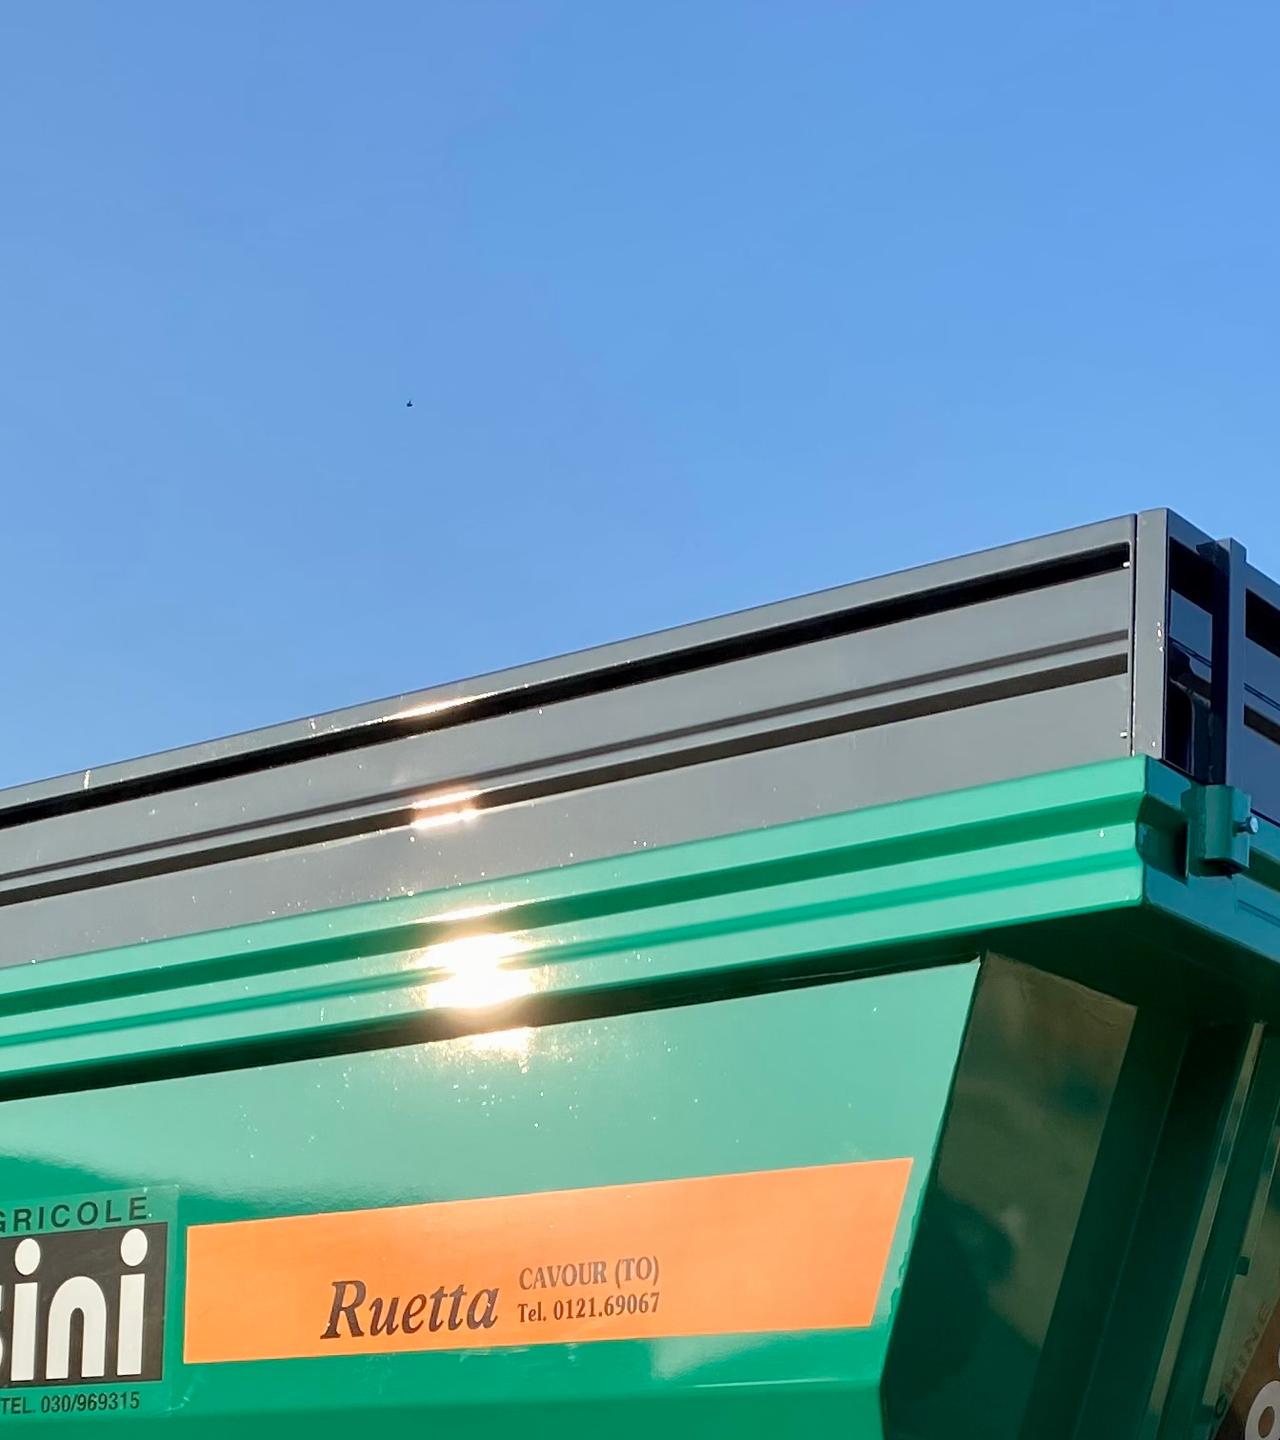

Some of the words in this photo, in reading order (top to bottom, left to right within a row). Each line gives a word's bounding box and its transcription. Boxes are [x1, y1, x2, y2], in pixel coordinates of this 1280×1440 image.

[519, 1259, 610, 1291] CAVOUR
[615, 1255, 660, 1288] (TO)
[320, 1279, 499, 1340] Ruetta
[517, 1302, 547, 1325] Tel.
[552, 1292, 661, 1321] 0121.69067
[0, 1396, 36, 1415] TEL.
[40, 1391, 141, 1414] 030/969315
